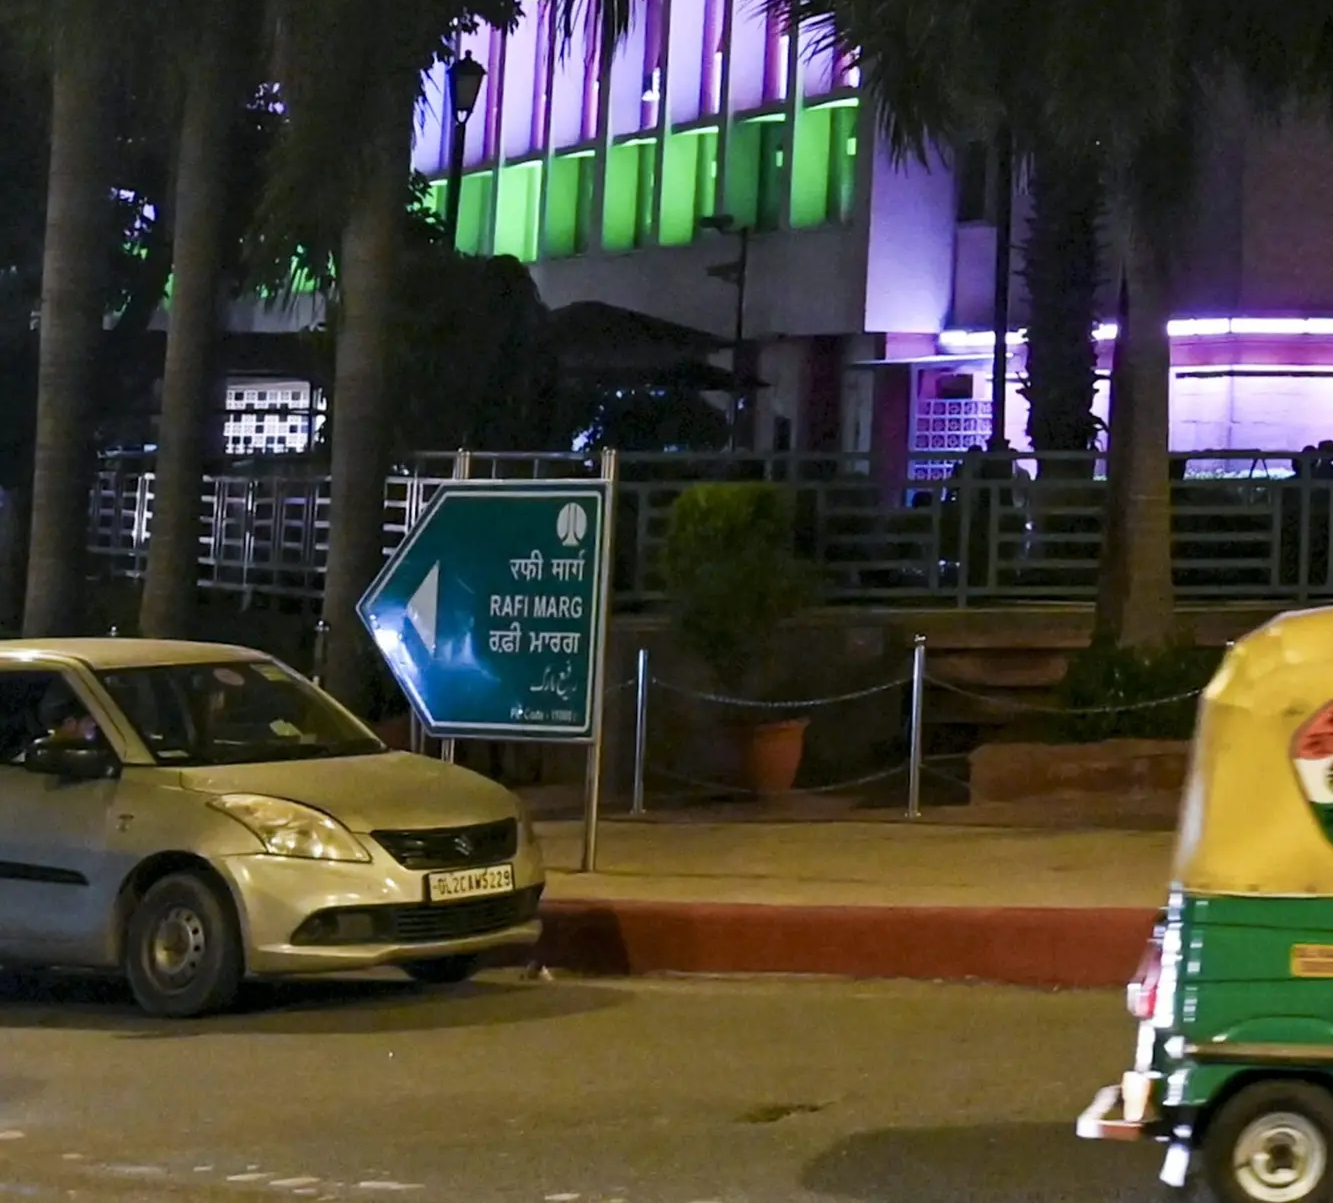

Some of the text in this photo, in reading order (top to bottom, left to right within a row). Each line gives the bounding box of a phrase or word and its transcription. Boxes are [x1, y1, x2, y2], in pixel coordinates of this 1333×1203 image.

[509, 549, 585, 581] रफी मार्ग
[490, 595, 583, 618] RAFI MARG
